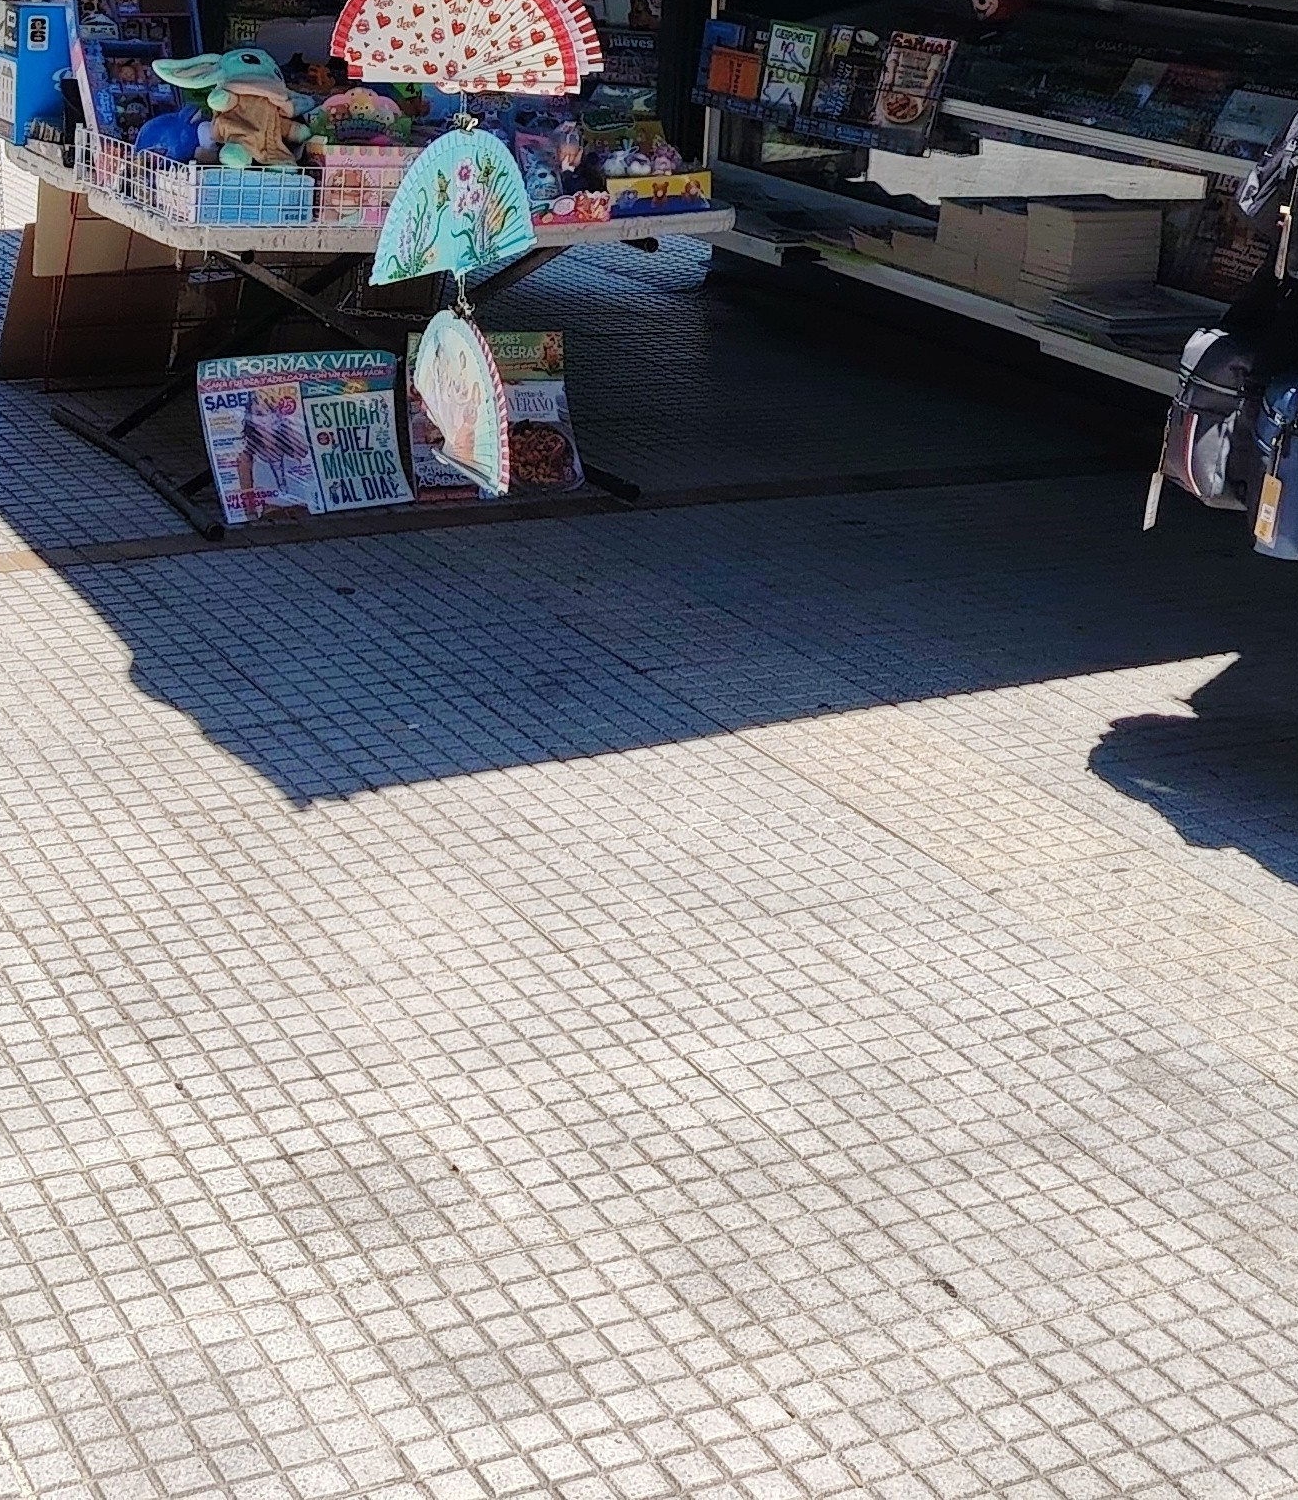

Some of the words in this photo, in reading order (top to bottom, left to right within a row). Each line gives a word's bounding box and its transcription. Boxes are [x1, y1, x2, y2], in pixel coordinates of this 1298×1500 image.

[205, 364, 231, 378] EN
[236, 357, 309, 376] FORMA
[328, 353, 388, 369] VITAL
[310, 397, 381, 428] ESTIRAR
[338, 427, 374, 452] DIEZ
[322, 451, 397, 479] MINUTOS
[340, 479, 362, 502] AL
